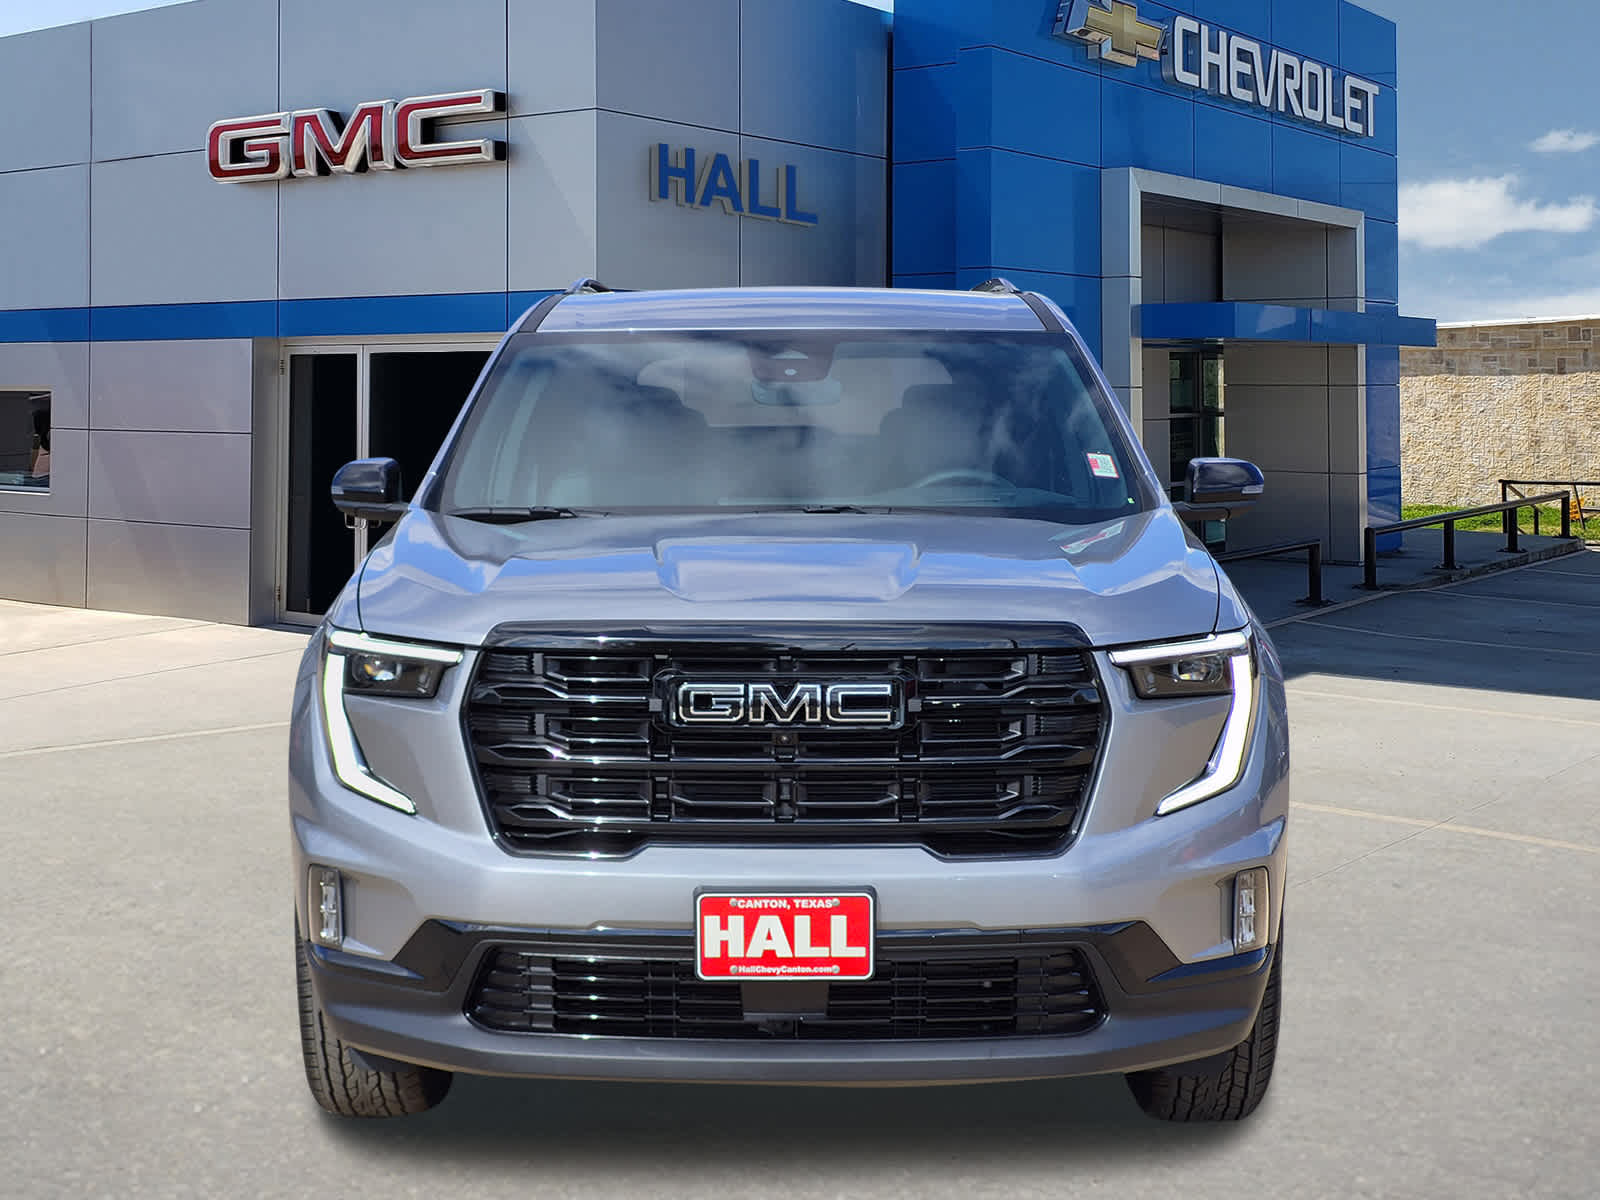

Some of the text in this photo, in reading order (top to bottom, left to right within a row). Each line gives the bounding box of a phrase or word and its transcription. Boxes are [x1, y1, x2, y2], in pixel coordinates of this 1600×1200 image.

[1174, 15, 1379, 137] CHEVROLET
[207, 88, 503, 184] GMC
[654, 143, 818, 226] HALL
[678, 683, 892, 722] GMC
[737, 898, 833, 910] CANTON, TEXAS
[704, 915, 866, 958] HALL
